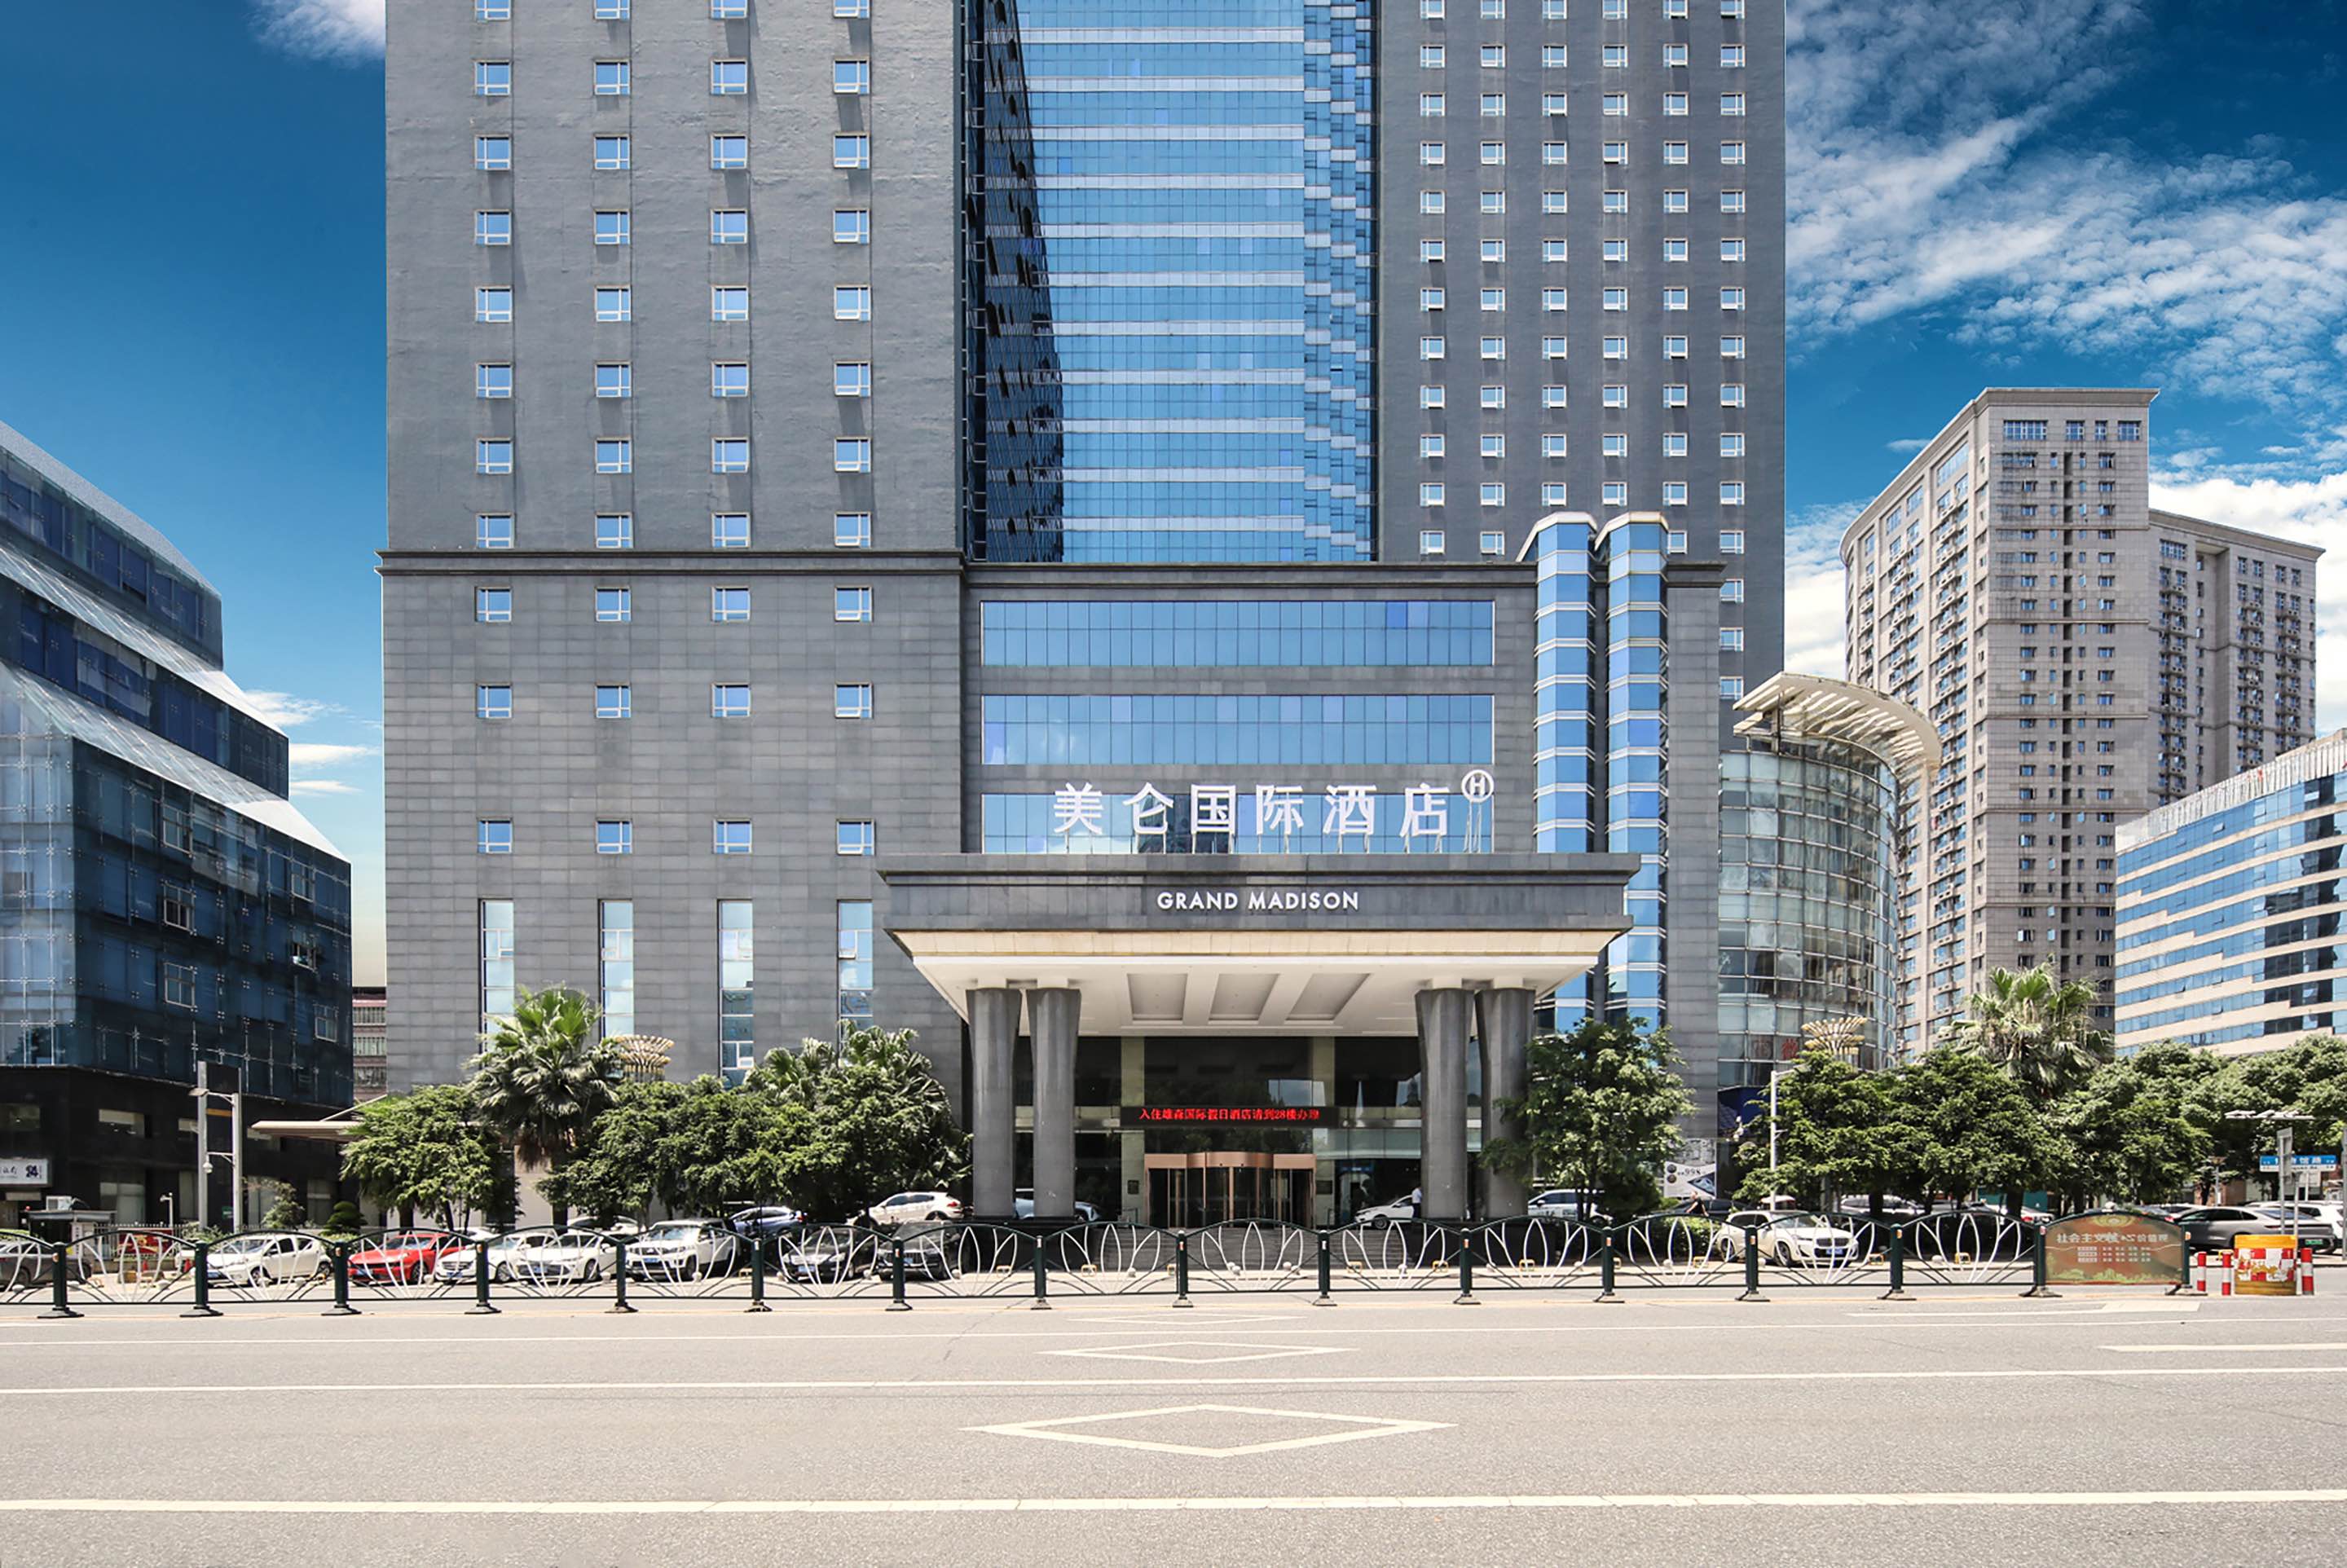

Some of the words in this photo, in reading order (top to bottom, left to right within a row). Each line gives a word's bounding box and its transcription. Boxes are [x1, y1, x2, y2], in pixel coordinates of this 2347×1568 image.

[1054, 782, 1449, 836] 美仑国际酒店
[1157, 892, 1238, 910] GRAND
[1248, 891, 1359, 910] MADISON
